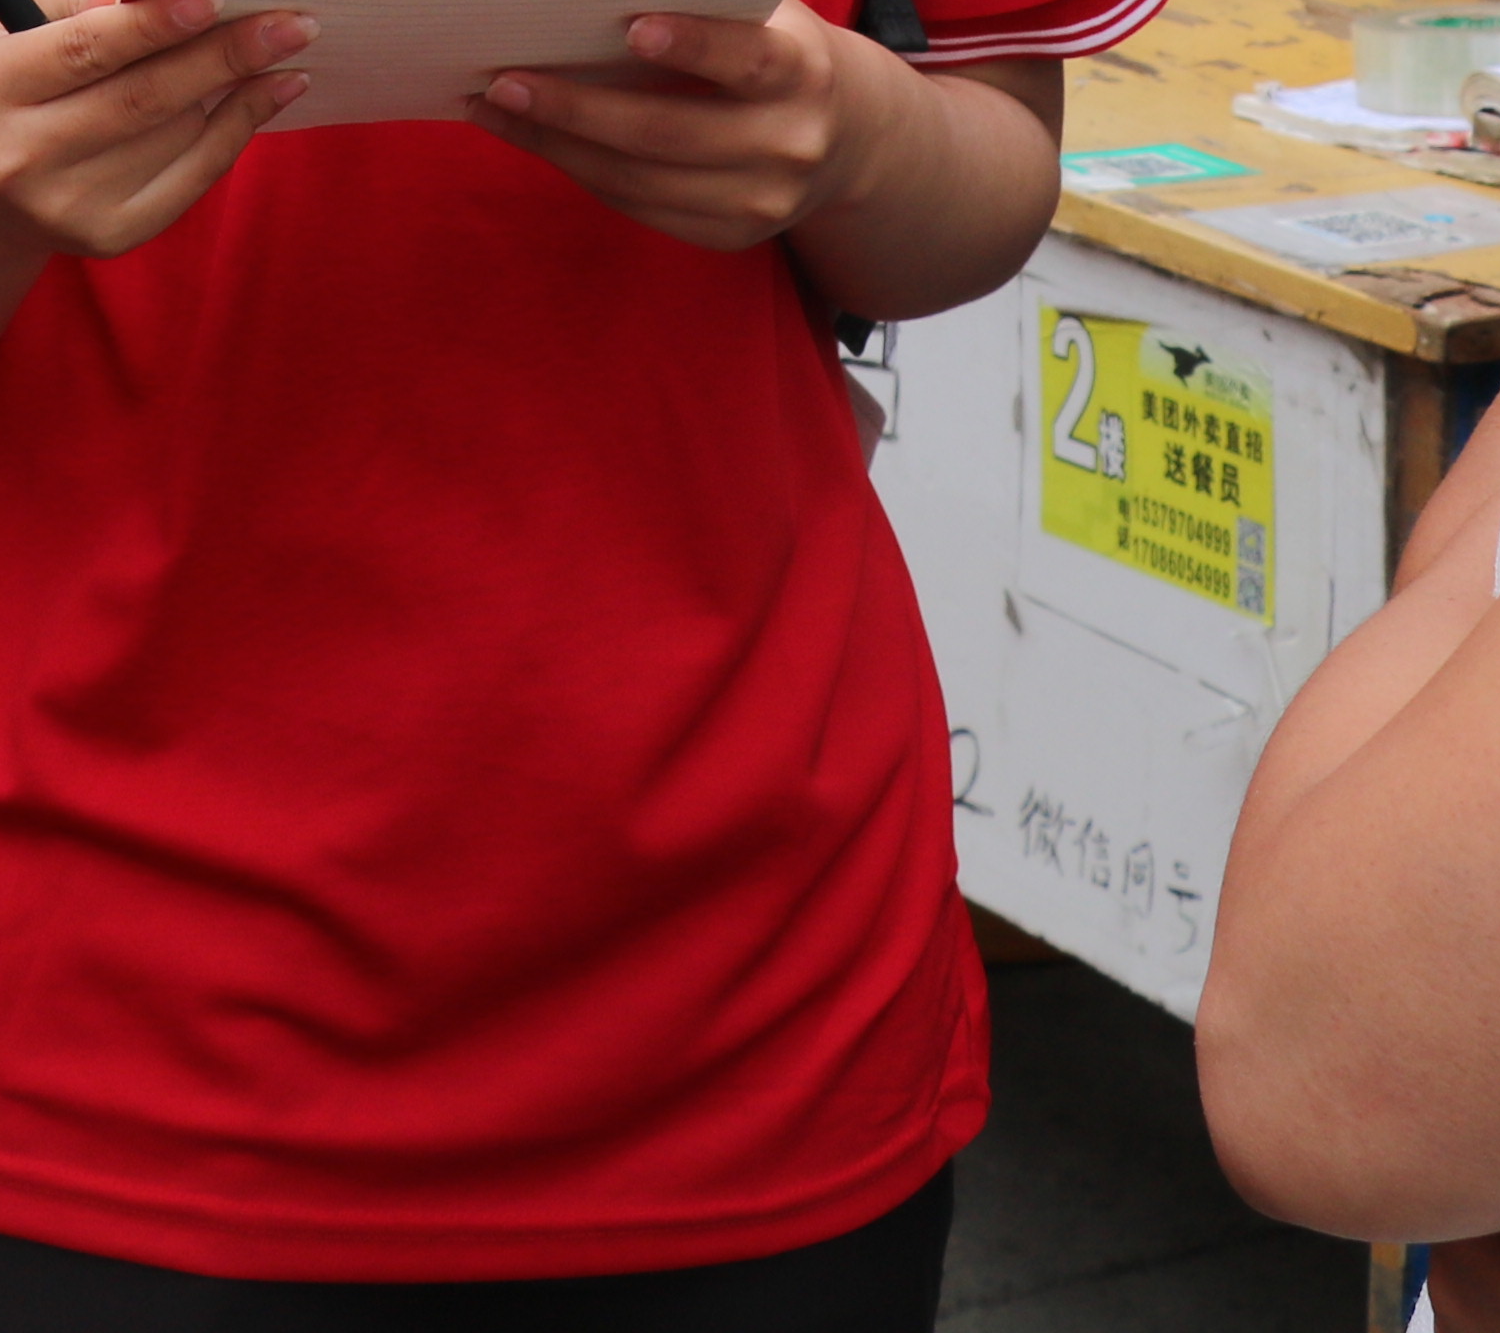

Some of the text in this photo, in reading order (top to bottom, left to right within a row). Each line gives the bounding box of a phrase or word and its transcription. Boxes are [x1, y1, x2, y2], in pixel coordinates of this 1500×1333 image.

[1142, 389, 1265, 466] 美团外卖直招
[1164, 441, 1242, 509] 送餐员
[1133, 495, 1234, 557] 15379704999
[1132, 536, 1233, 600] 17086054999
